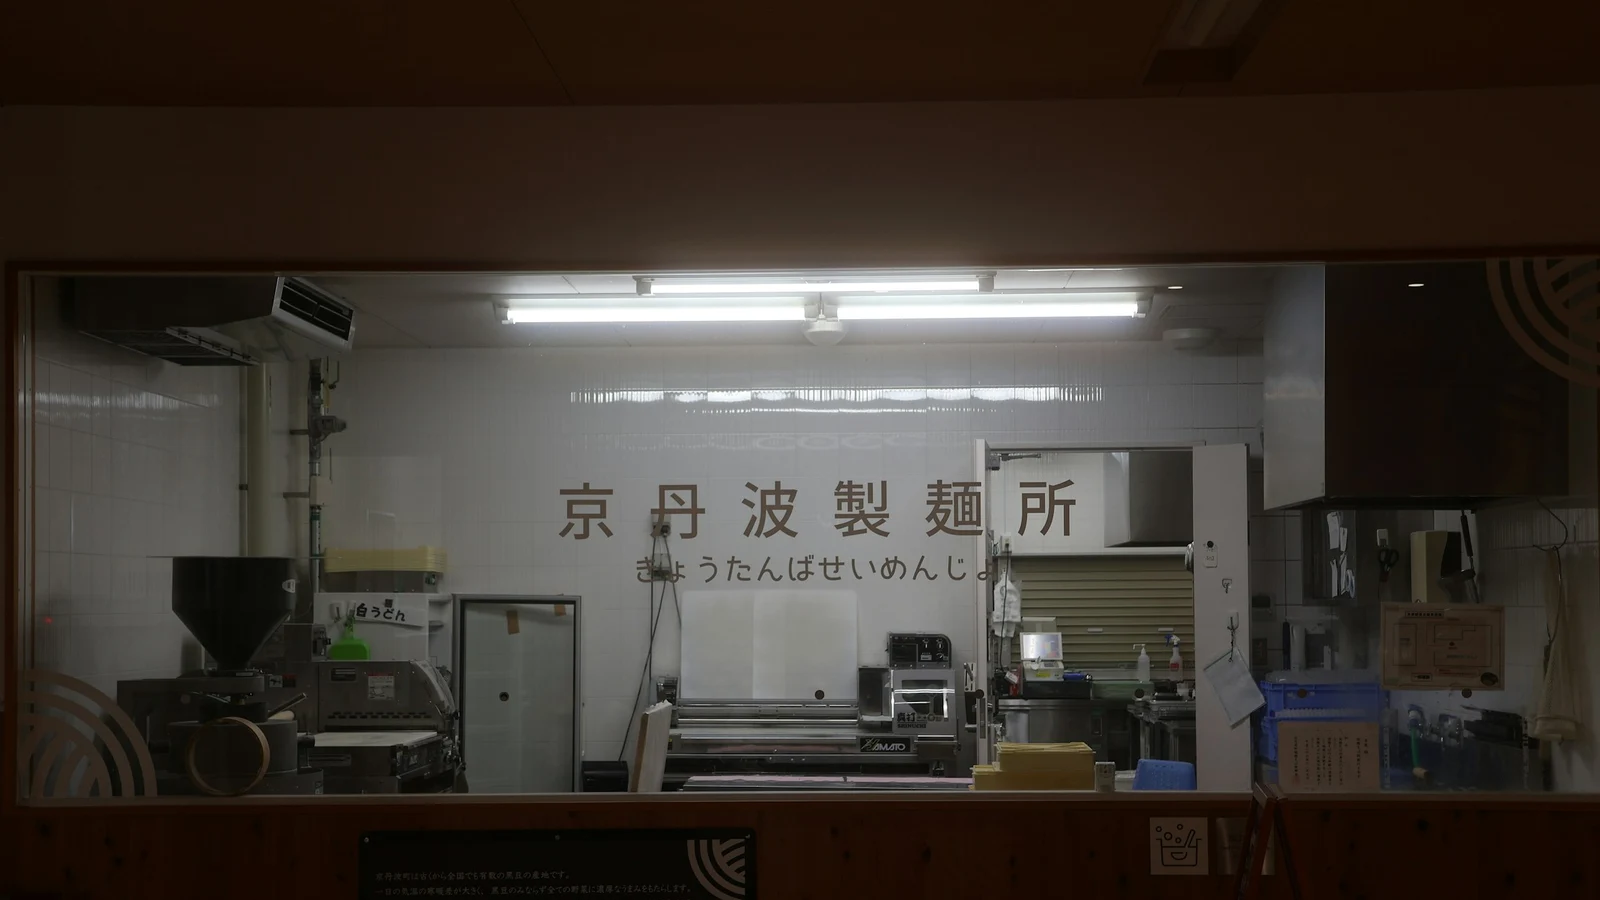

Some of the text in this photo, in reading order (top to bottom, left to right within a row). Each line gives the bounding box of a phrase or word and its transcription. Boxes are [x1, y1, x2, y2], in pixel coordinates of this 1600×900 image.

[558, 479, 1077, 540] 京丹波製麺所
[636, 555, 994, 583] きょうたんばせいめんじょ
[356, 602, 406, 622] 白うどん
[861, 737, 906, 752] YAMATO
